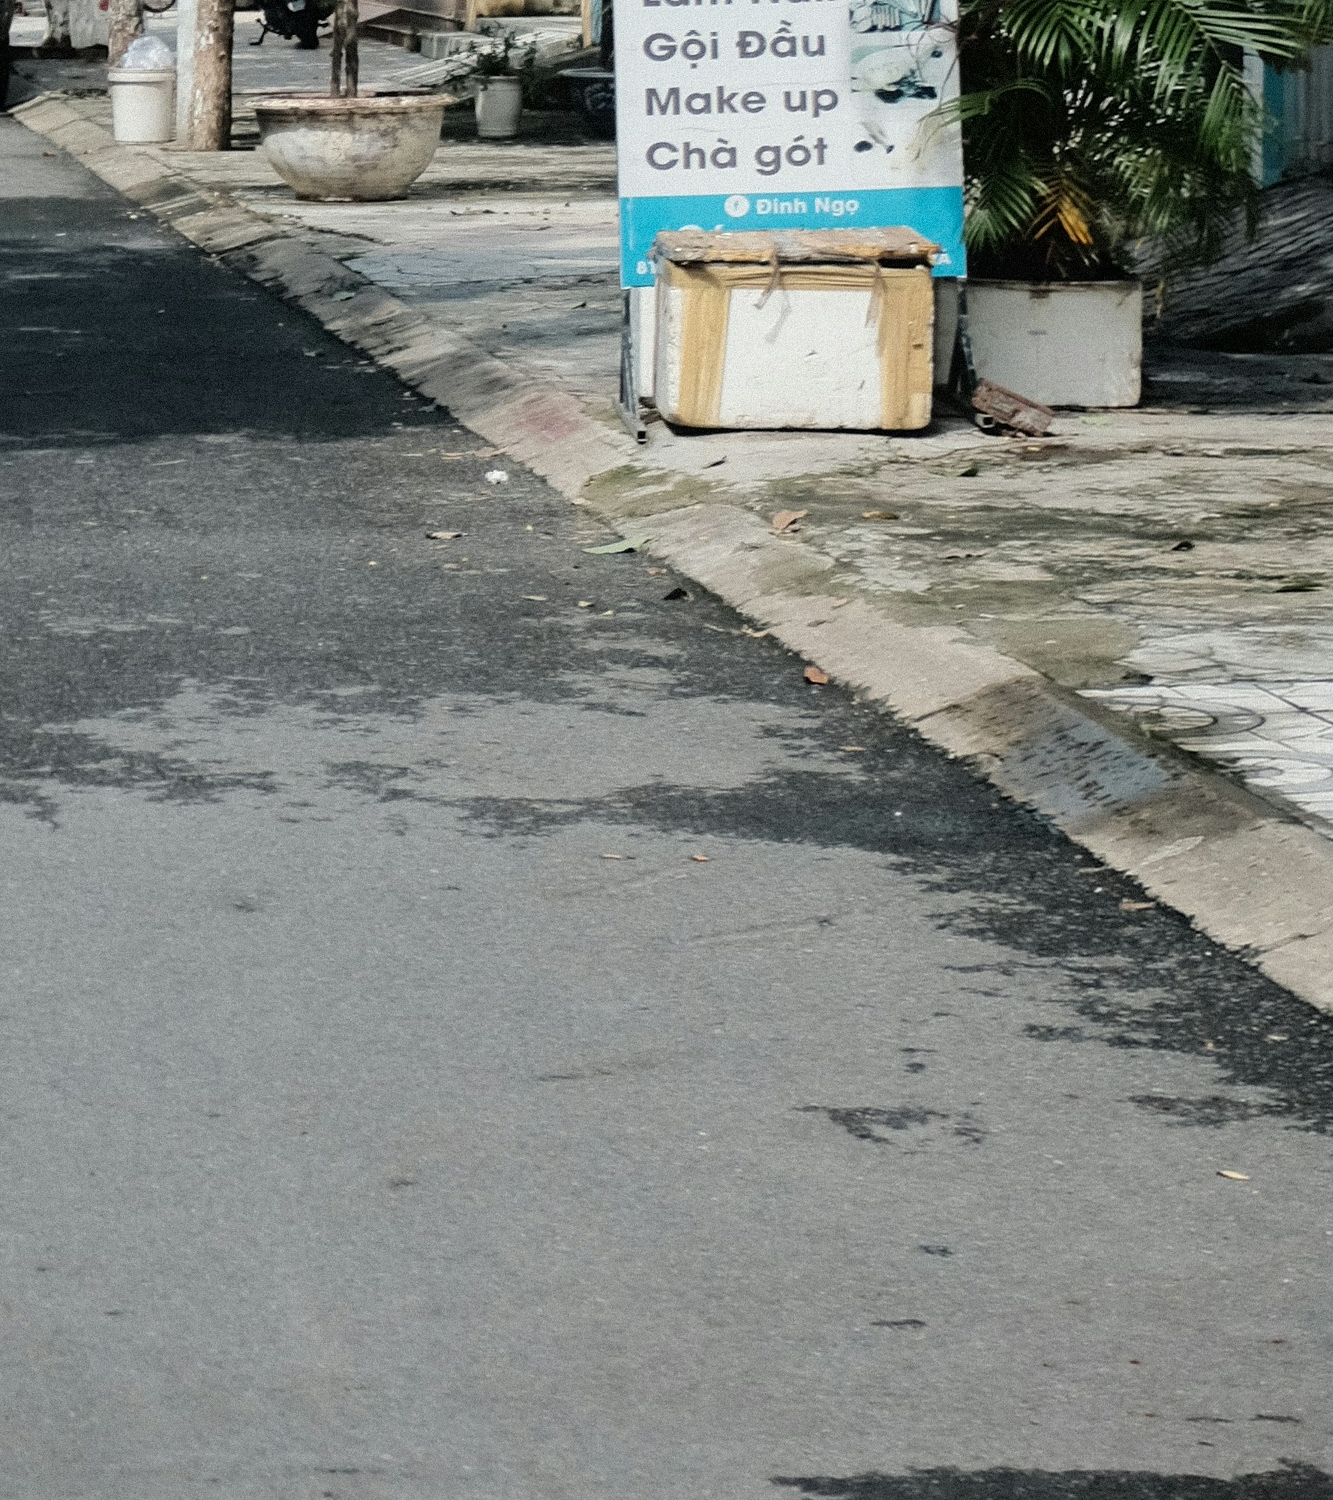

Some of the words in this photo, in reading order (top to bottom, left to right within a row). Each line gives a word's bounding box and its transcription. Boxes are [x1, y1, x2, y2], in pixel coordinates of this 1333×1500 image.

[643, 29, 719, 69] Gội
[735, 19, 826, 59] Đầu
[645, 85, 767, 116] Make
[783, 88, 839, 118] up
[645, 138, 738, 171] Chà
[753, 134, 829, 176] gót
